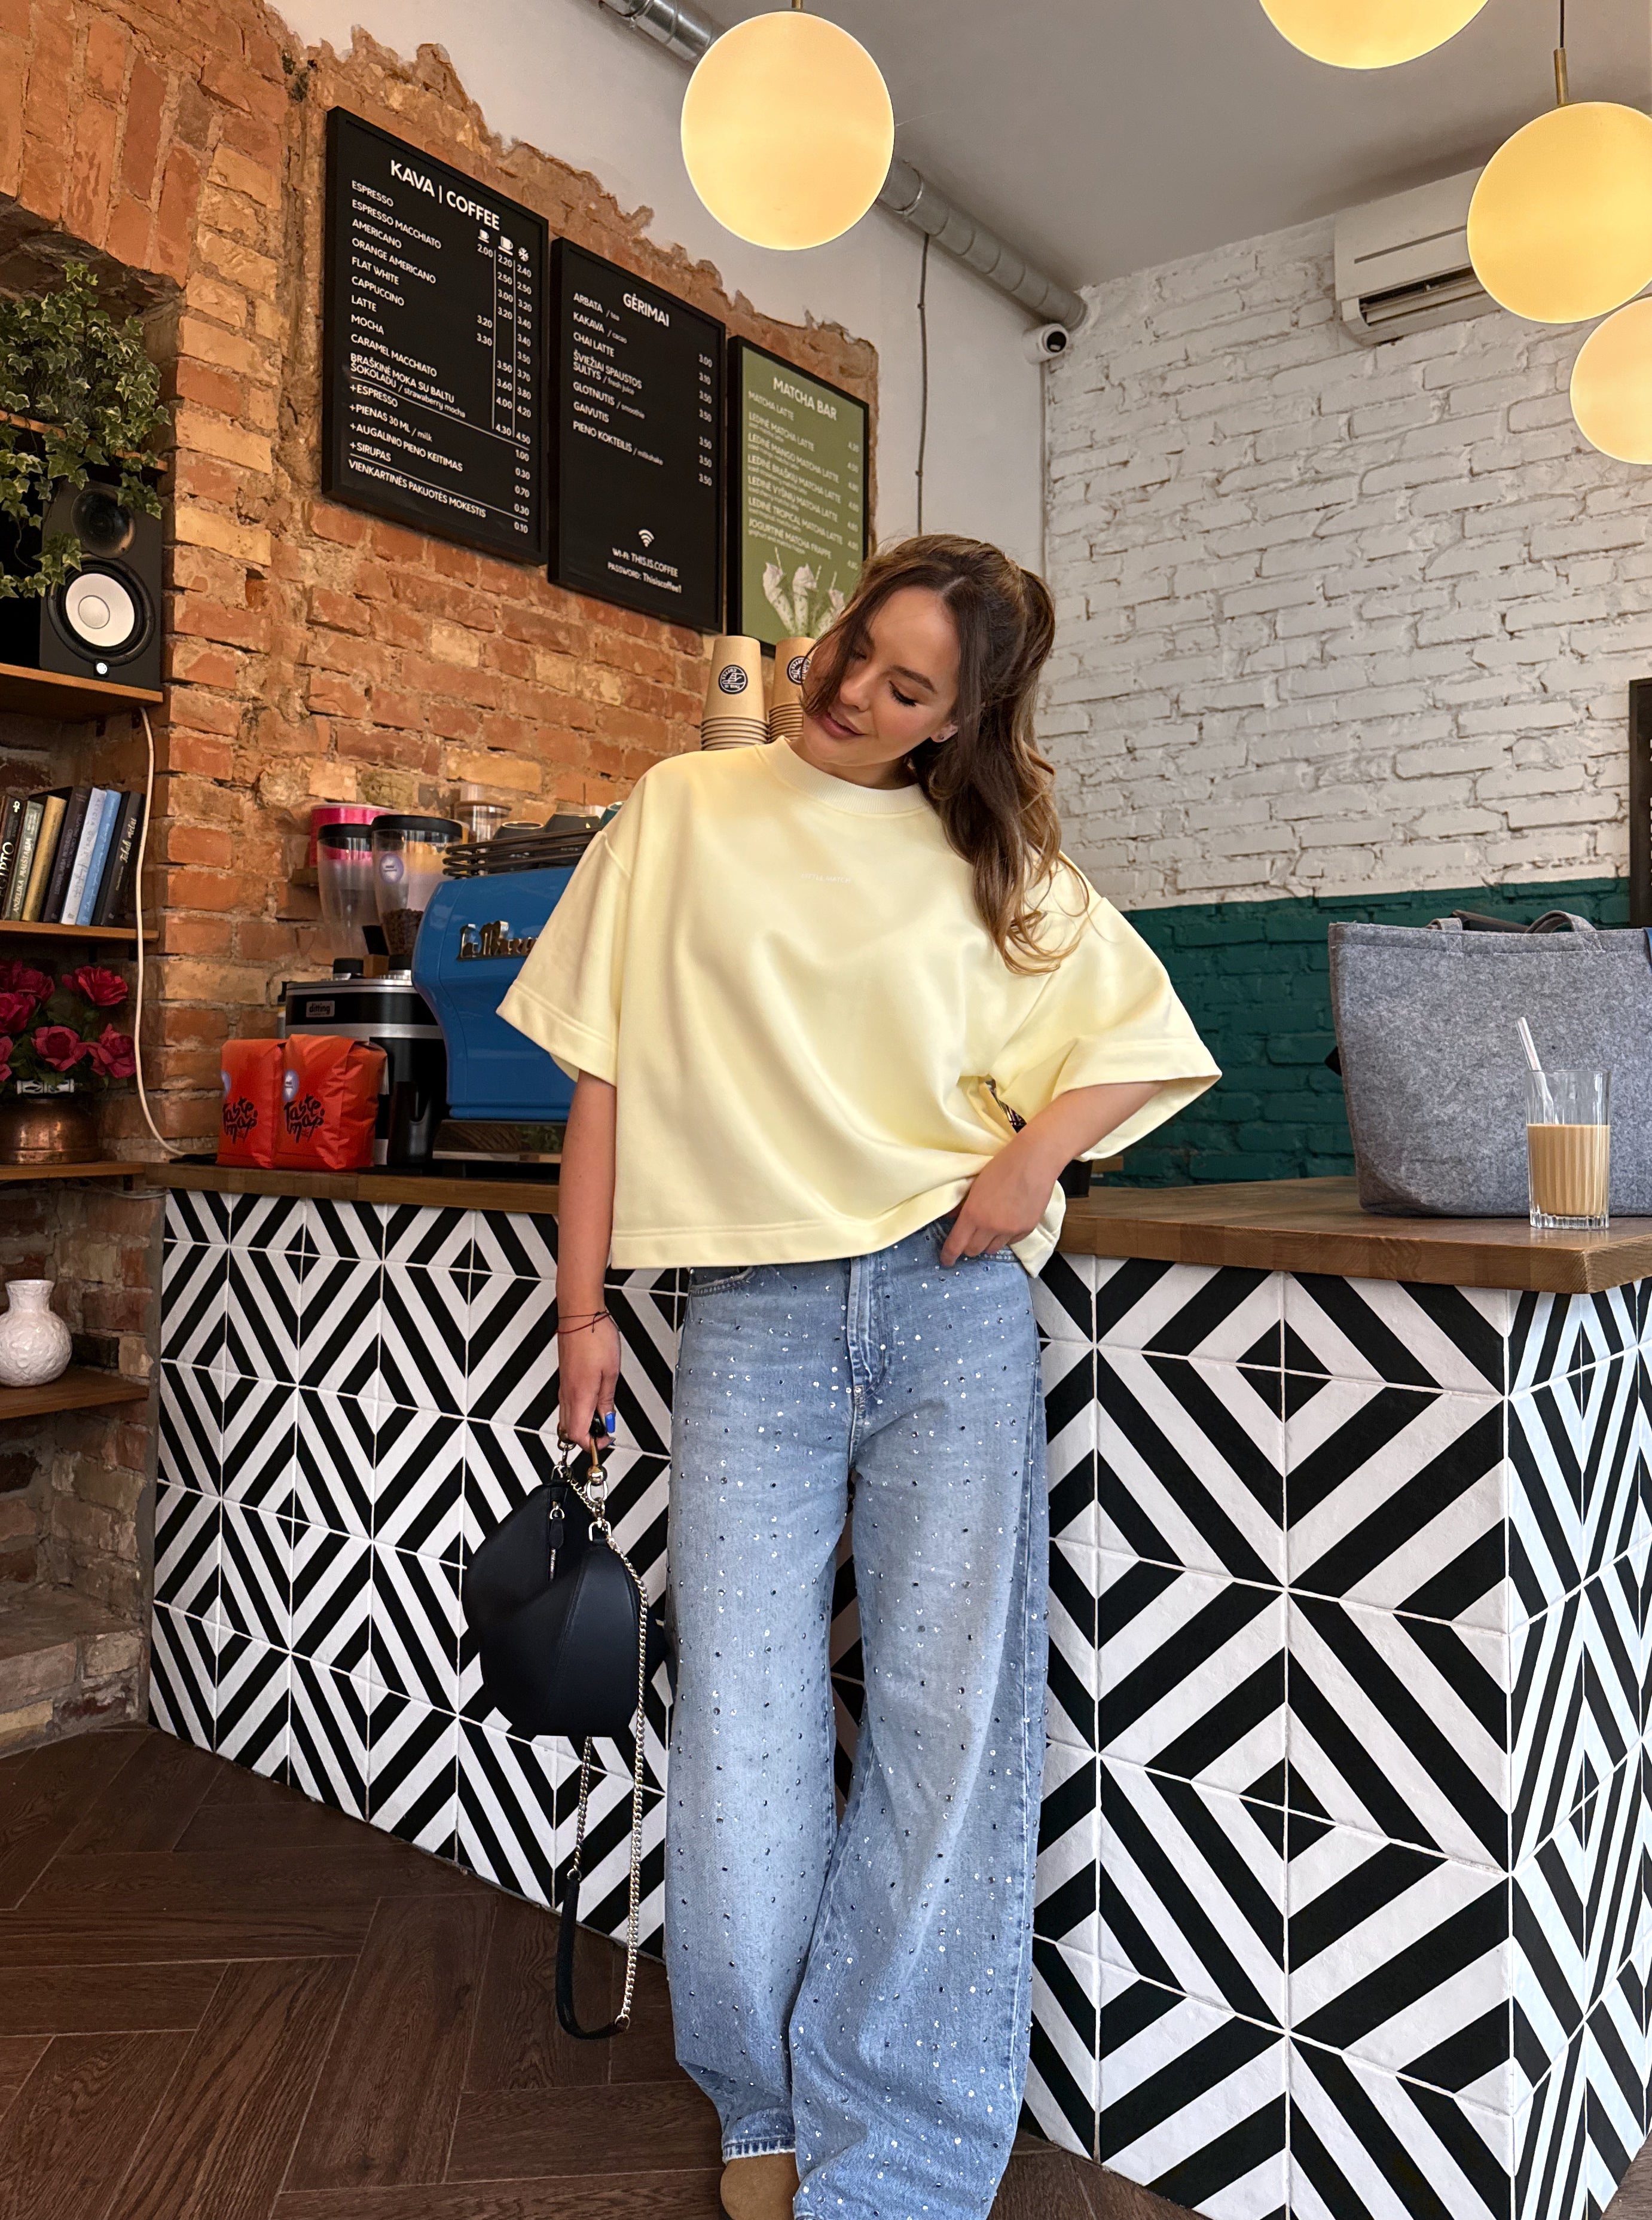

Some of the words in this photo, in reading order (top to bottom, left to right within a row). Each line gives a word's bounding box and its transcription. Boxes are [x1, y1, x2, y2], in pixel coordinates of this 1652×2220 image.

[352, 181, 393, 206] ESPRESSO
[391, 160, 435, 197] KAVA
[447, 191, 499, 231] COFFEE
[352, 199, 393, 225] ESPRESSO
[395, 220, 441, 249] MACCHIATO
[352, 219, 402, 248] AMERICANO
[352, 238, 387, 261] ORANGE
[389, 255, 436, 283] AMERICANO
[352, 256, 372, 271] FLAT
[373, 265, 399, 285] WHITE
[352, 276, 404, 306] CAPPUCCINO
[352, 295, 376, 312] LATTE
[573, 293, 603, 313] ARBATA
[573, 312, 604, 333] KAKAVA
[623, 293, 669, 326] GĖRIMAI
[352, 314, 384, 335] MOCHA
[351, 334, 390, 356] CARAMEL
[391, 350, 436, 377] MACCHIATO
[573, 332, 592, 347] CHAI
[593, 341, 614, 357] LATTE
[350, 361, 396, 387] ŠOKOLADU
[350, 353, 391, 377] BRAŠKINĖ
[392, 370, 416, 387] MOKA
[418, 381, 429, 392] SU
[430, 386, 454, 403] BALTU
[573, 349, 604, 372] ŠVIEŽIAI
[606, 365, 642, 389] SPAUSTOS
[573, 361, 601, 380] SULTYS
[573, 381, 615, 405] GLOTNUTIS
[774, 377, 815, 410] MATCHA
[817, 400, 836, 420] BAR
[389, 416, 398, 426] 30
[400, 420, 410, 432] ML
[573, 402, 609, 422] GAIVUTIS
[573, 421, 597, 436] PIENO
[598, 430, 632, 452] KOKTEILIS
[404, 441, 426, 457] PIENO
[427, 451, 463, 471] KEITIMAS
[348, 459, 408, 488] VIENKARTINĖS
[409, 481, 447, 503] PAKUOTĖS
[449, 497, 485, 517] MOKESTIS
[309, 1004, 331, 1015] ditting
